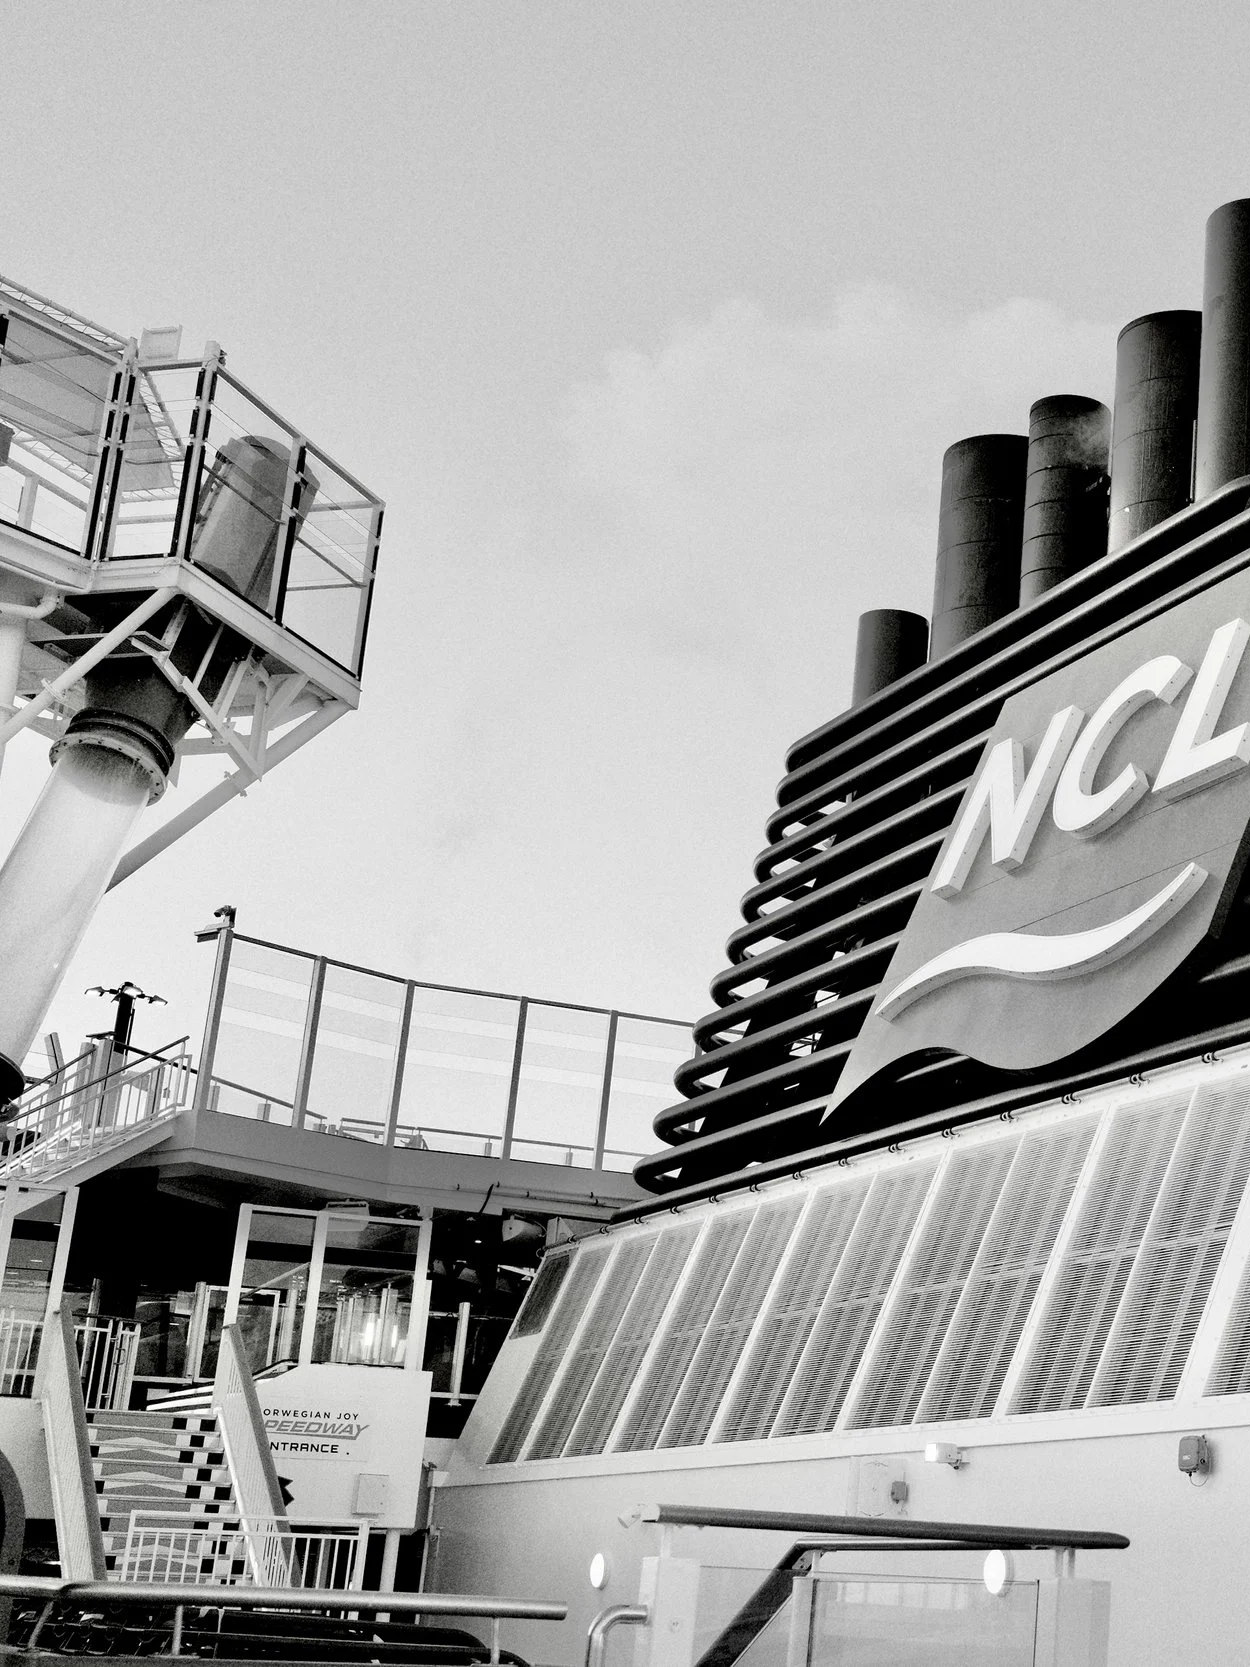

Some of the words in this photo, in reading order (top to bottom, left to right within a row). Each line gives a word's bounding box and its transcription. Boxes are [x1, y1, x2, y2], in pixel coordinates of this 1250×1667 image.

[263, 1408, 331, 1419] ORWEGIAN
[337, 1412, 359, 1420] JOY
[264, 1420, 370, 1440] PEEDWAY
[270, 1441, 339, 1454] NTRANCE
